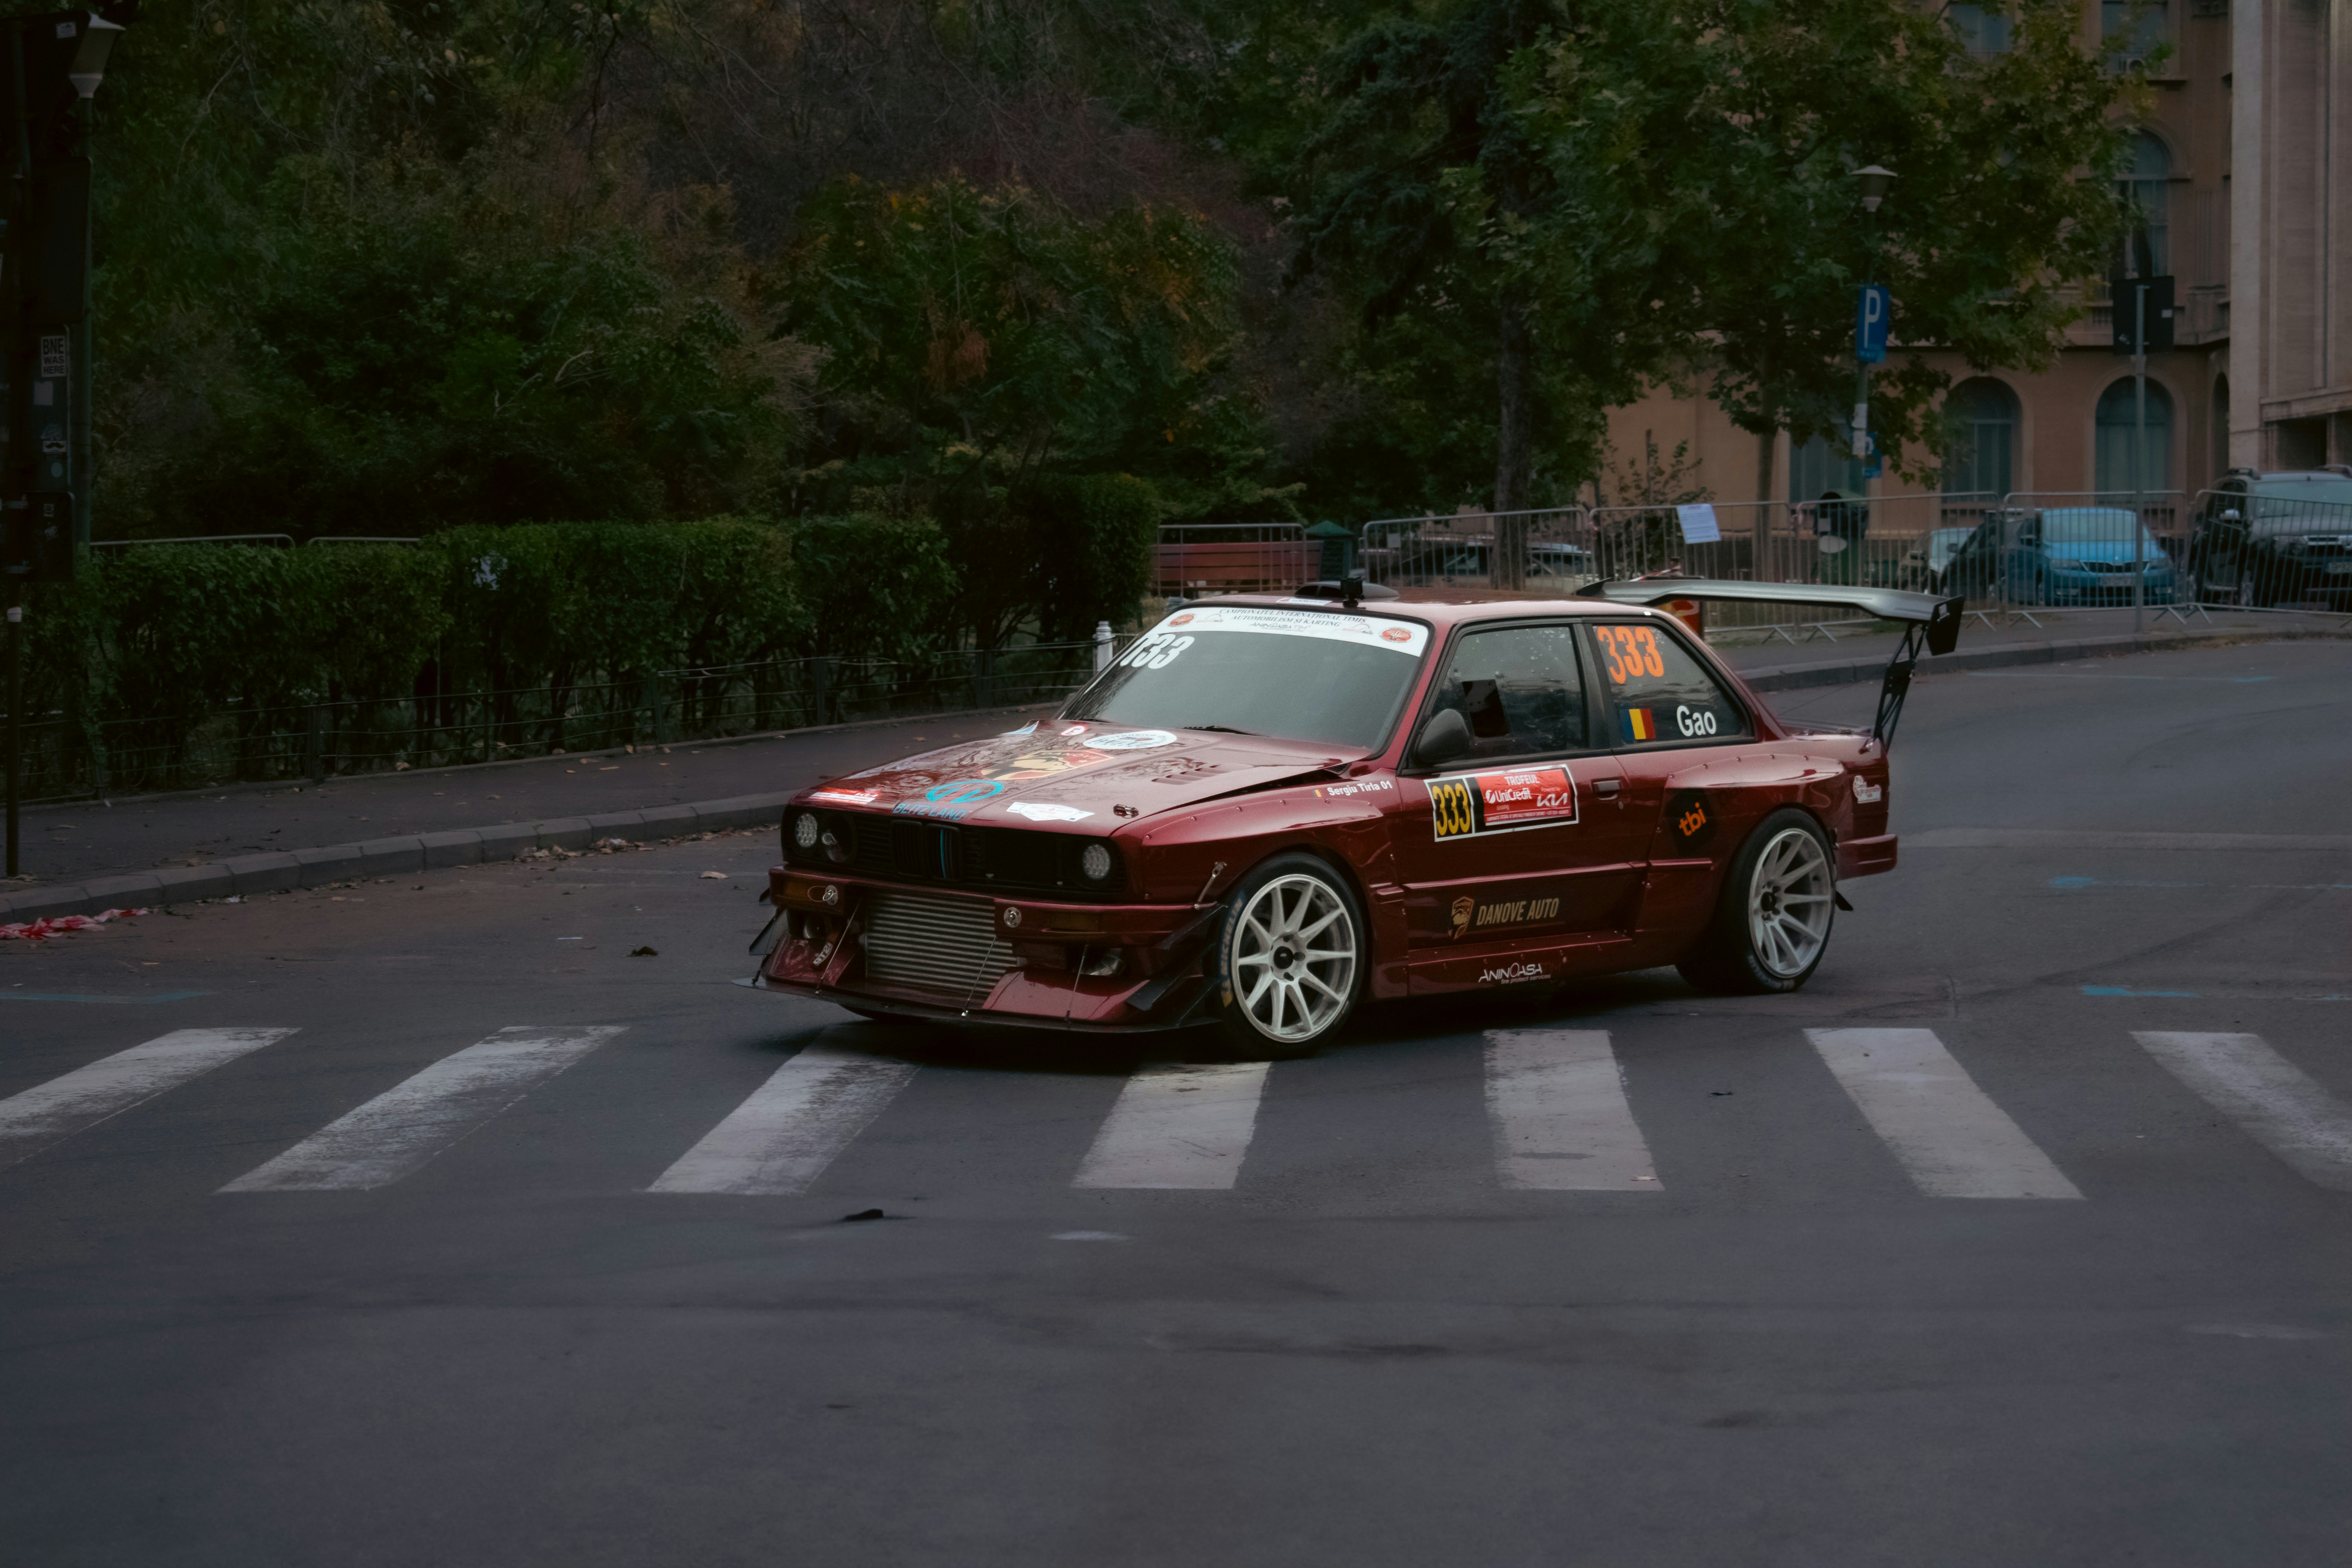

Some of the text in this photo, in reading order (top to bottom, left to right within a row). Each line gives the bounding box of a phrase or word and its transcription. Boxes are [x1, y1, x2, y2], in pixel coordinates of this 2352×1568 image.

[1865, 289, 1880, 348] P
[43, 338, 64, 354] BNE
[44, 355, 64, 364] WAS
[44, 365, 64, 374] HERE
[1597, 626, 1664, 684] 333
[1677, 705, 1717, 737] Gao
[1327, 785, 1358, 796] Sergiu
[1380, 780, 1393, 789] 01
[1504, 775, 1540, 786] TROFEUL
[1495, 788, 1532, 802] UniCredit
[892, 804, 966, 820] BLITZ LAND
[1432, 783, 1470, 836] 333
[1679, 802, 1706, 836] tbi
[1476, 898, 1560, 926] DANOVE AUTO
